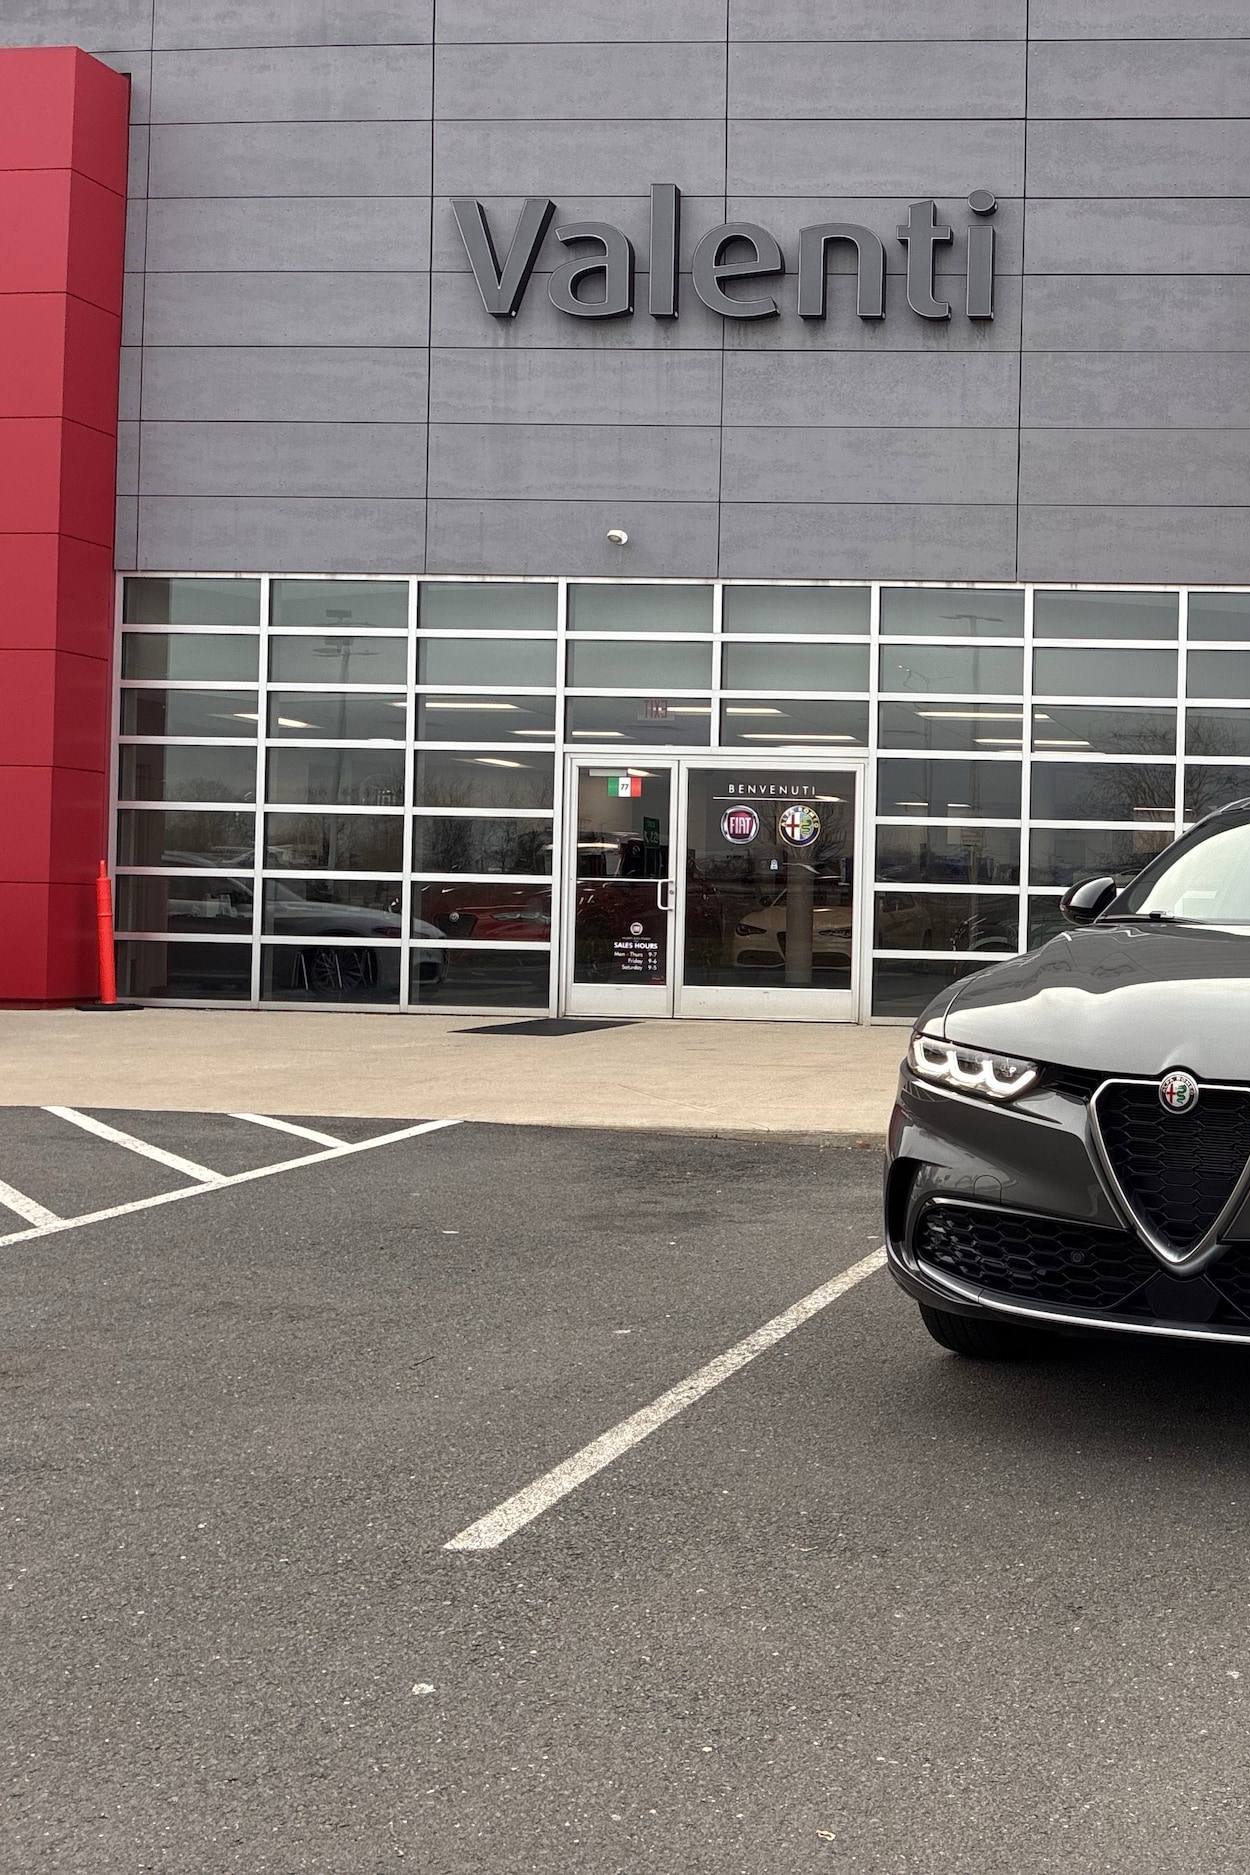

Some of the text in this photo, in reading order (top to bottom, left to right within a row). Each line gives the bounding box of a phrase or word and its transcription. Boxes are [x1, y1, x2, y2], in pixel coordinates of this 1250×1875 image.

[449, 182, 999, 320] Valenti
[620, 783, 630, 791] 77
[728, 784, 816, 796] BENVENUTI
[729, 817, 752, 834] FIAT
[613, 941, 633, 949] SALES
